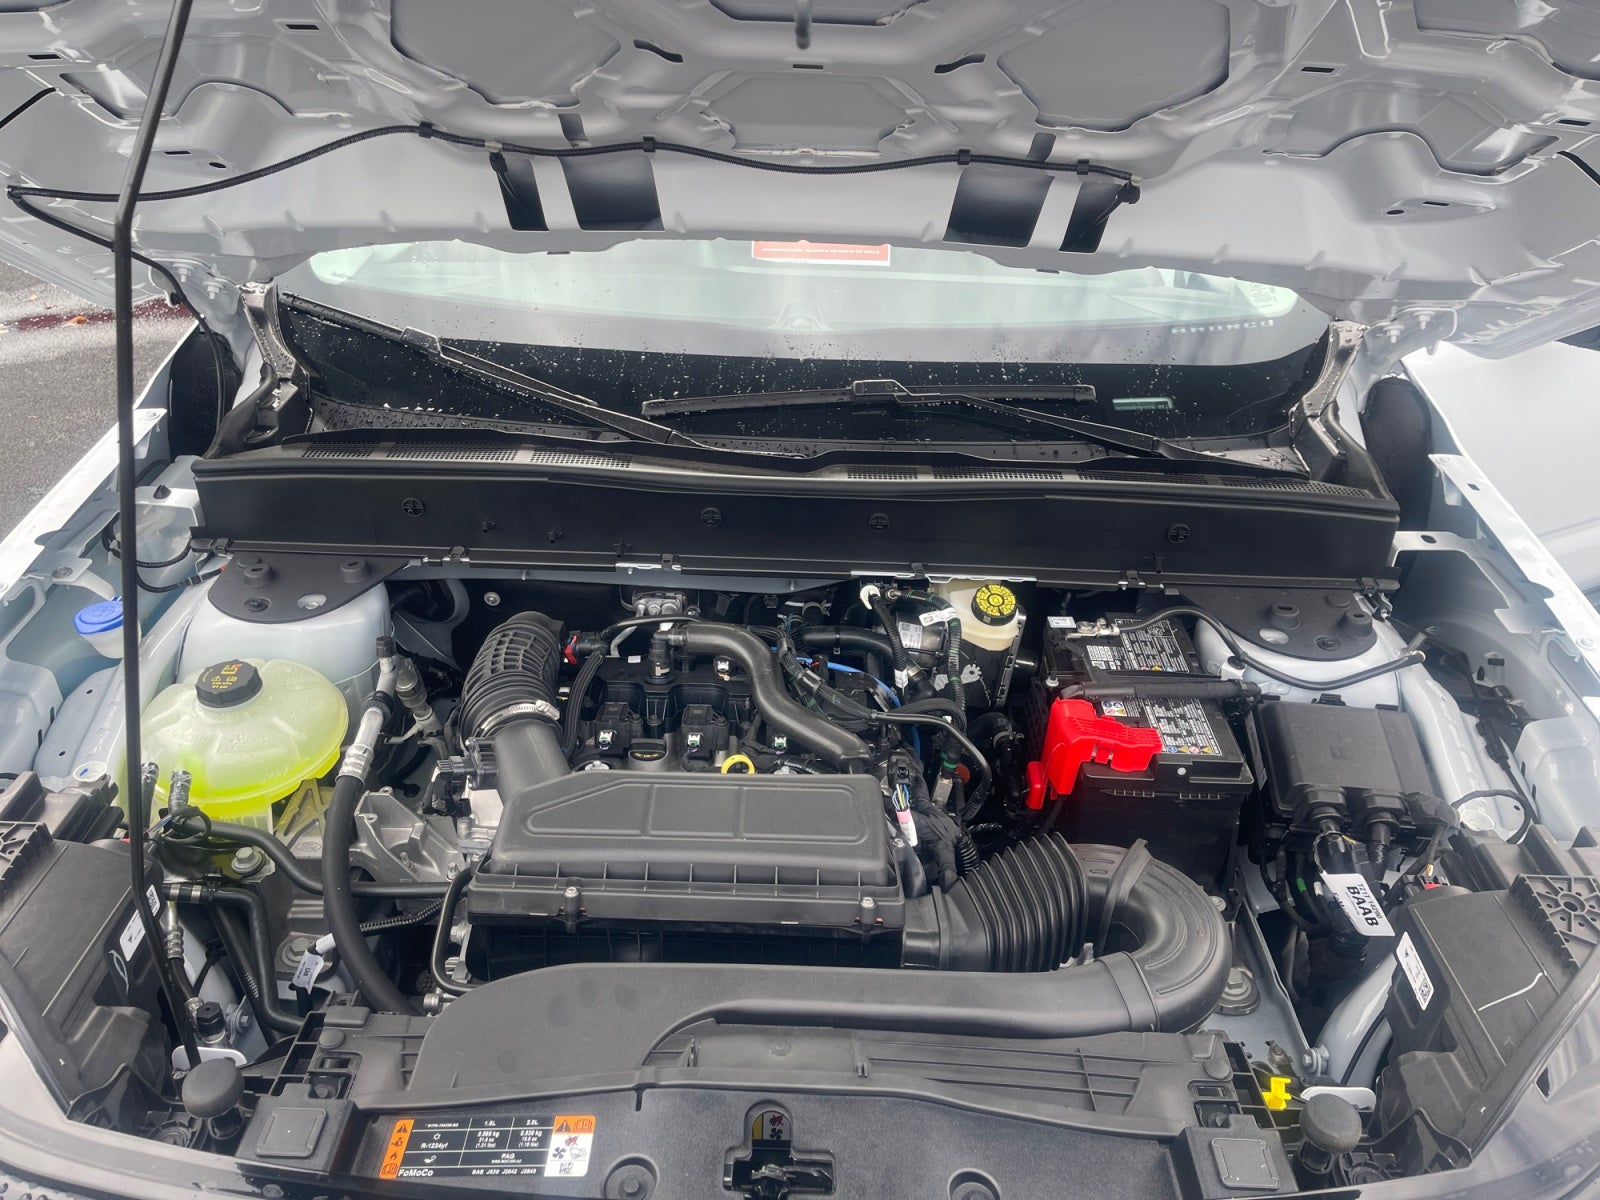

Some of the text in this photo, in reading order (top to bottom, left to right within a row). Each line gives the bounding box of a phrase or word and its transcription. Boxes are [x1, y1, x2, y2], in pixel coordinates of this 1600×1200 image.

[1346, 886, 1379, 926] BAAB
[420, 1142, 449, 1150] R-1234yf
[398, 1168, 434, 1177] FoMoCo
